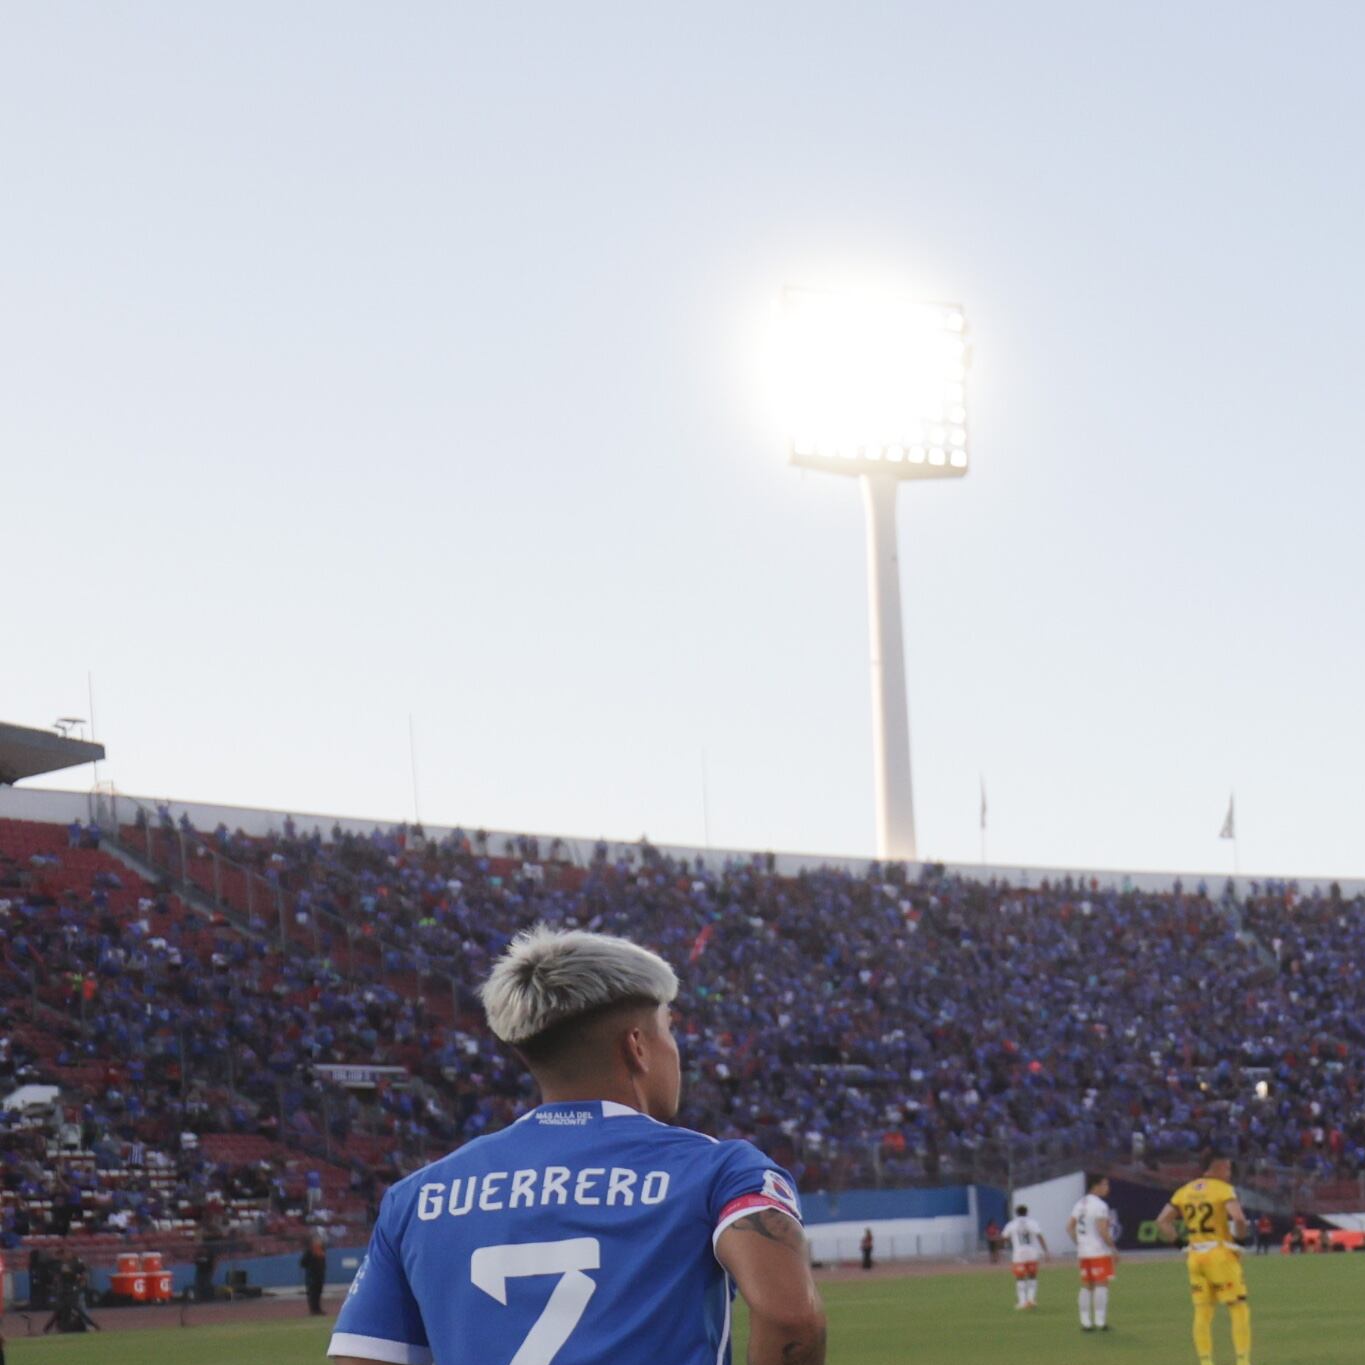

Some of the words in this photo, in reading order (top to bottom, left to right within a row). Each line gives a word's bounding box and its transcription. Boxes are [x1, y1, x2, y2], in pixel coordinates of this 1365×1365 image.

[577, 1111, 594, 1119] DEL
[418, 1166, 670, 1221] GUERRERO
[1184, 1203, 1215, 1233] 22
